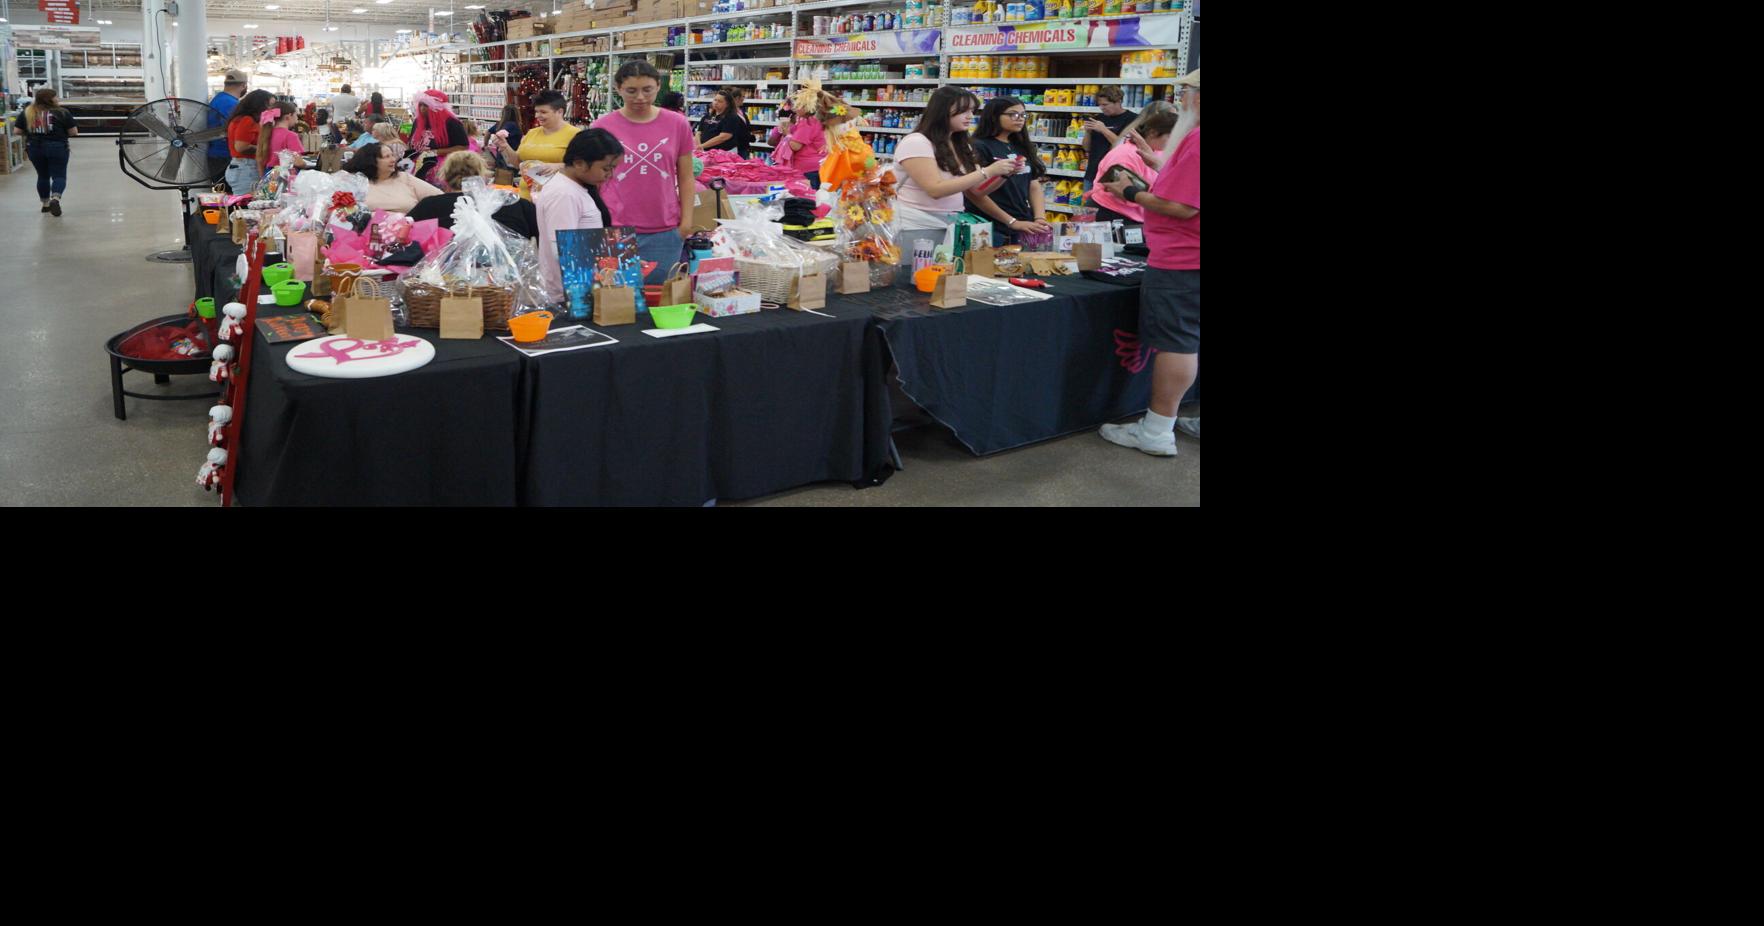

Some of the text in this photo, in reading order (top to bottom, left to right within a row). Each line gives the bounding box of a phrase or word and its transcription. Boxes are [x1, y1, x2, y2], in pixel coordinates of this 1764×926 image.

[952, 28, 1076, 47] CLEANING CHEMICALS
[797, 40, 877, 55] CLEANING CHEMICALS
